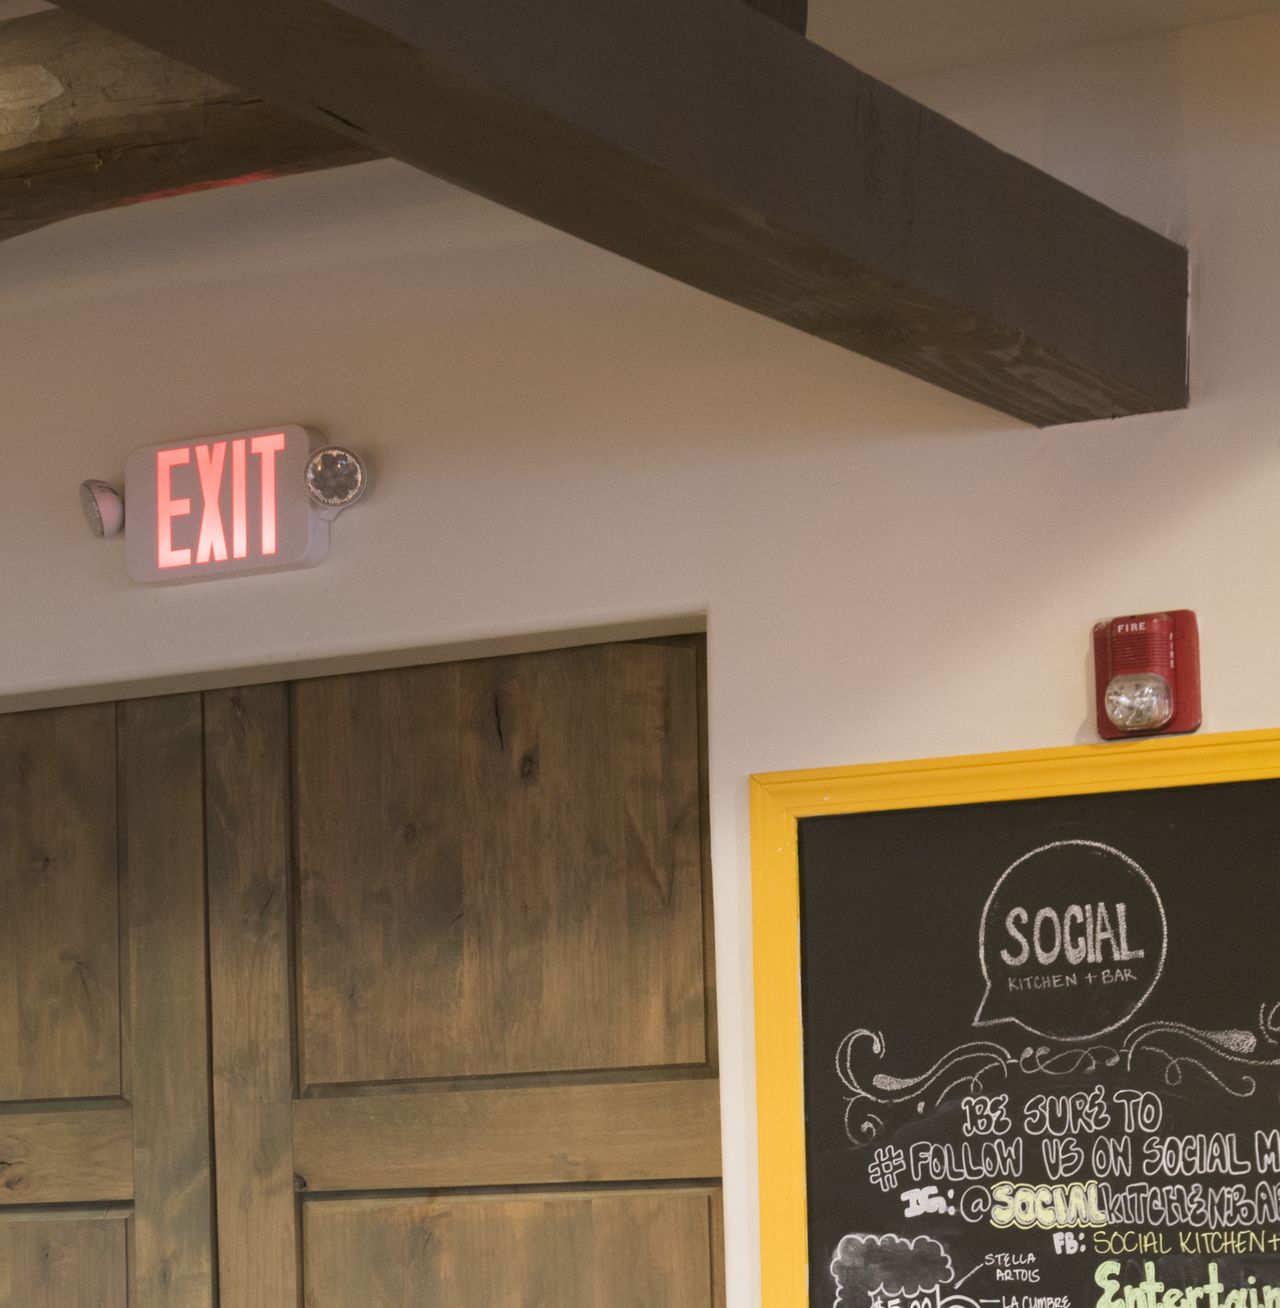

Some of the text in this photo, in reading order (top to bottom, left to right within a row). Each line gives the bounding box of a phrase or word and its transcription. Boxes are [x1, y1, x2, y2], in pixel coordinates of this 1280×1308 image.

[155, 432, 286, 569] EXIT
[1117, 622, 1146, 633] FIRE
[1000, 902, 1144, 966] SOCIAL
[1008, 968, 1137, 991] KITCHEN + BAR
[962, 1085, 1162, 1136] BE SURE TO
[1042, 1138, 1084, 1179] US
[1092, 1136, 1132, 1179] ON
[1143, 1130, 1251, 1177] SOCIAL
[1052, 1232, 1086, 1254] FB:
[1093, 1231, 1171, 1254] SOCIAL
[984, 1253, 1036, 1267] STELLA
[996, 1268, 1041, 1283] ARTOIS
